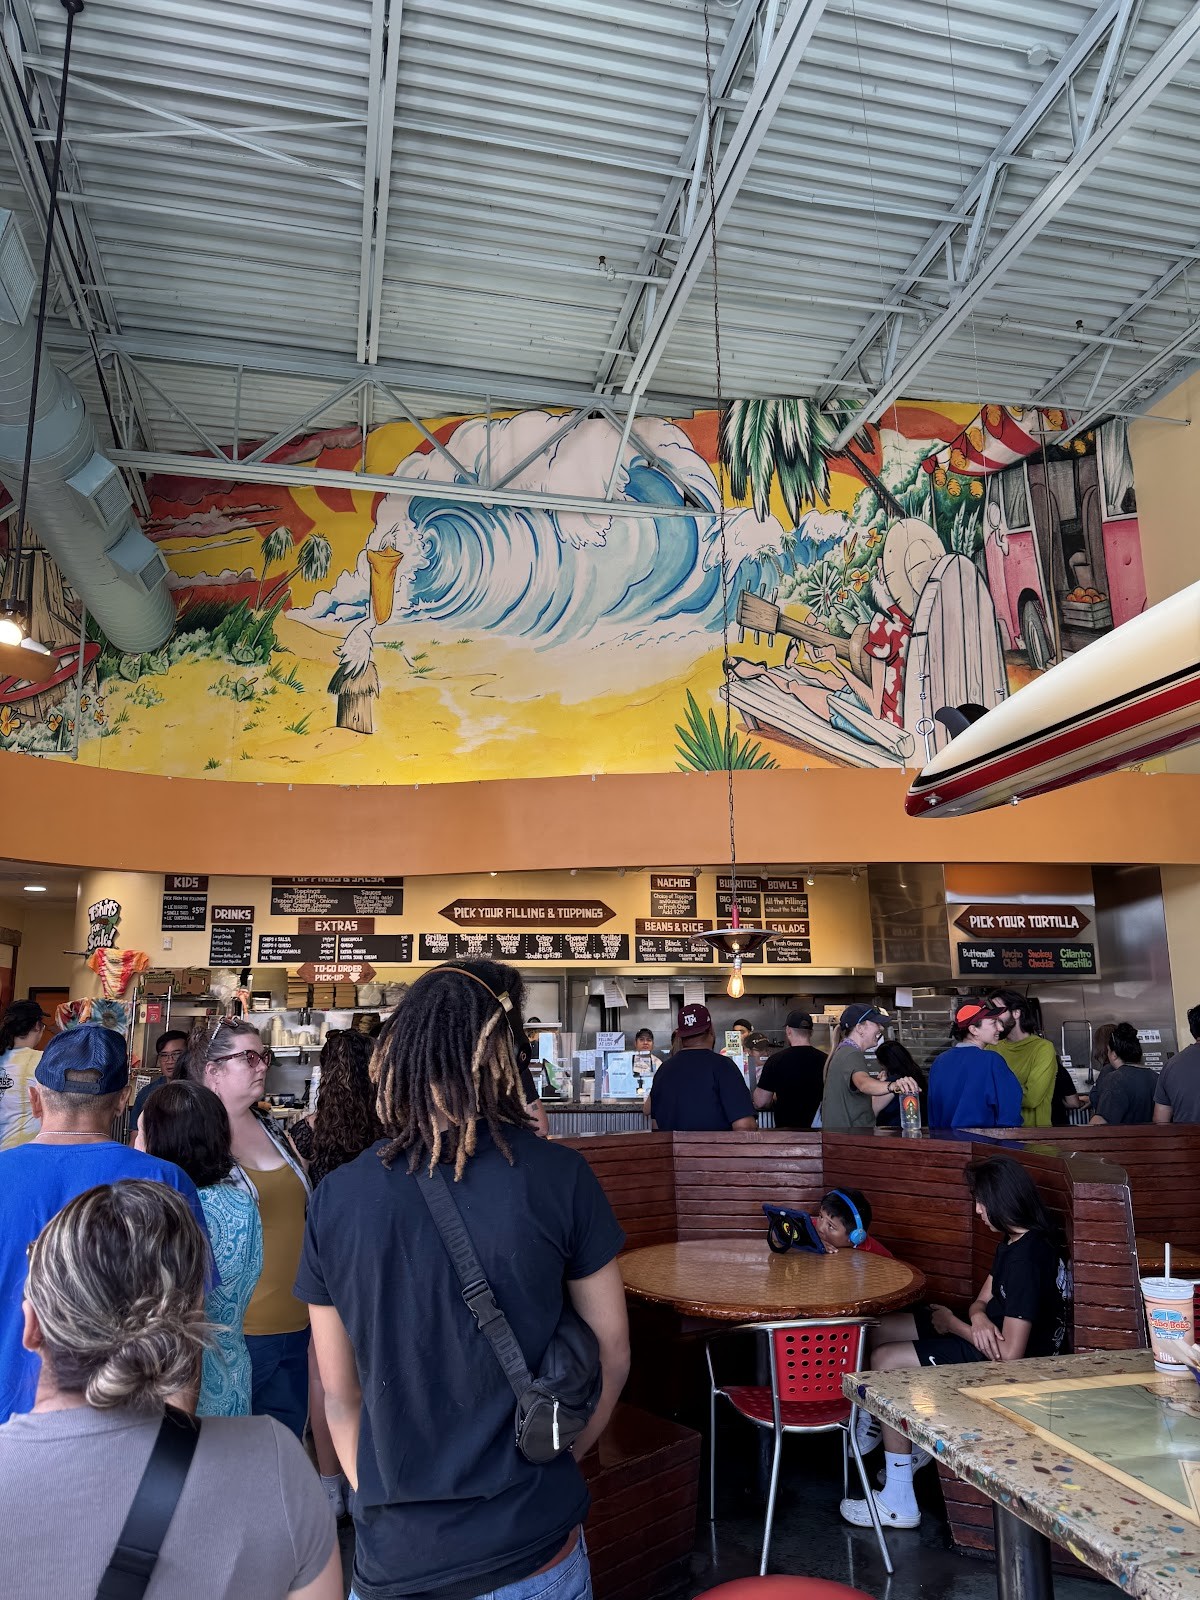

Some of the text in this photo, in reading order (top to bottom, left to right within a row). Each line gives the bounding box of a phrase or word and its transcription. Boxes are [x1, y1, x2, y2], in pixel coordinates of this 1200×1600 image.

[173, 877, 199, 888] KIDS
[657, 878, 691, 888] NACHOS
[768, 880, 798, 890] BOWLS
[719, 895, 731, 903] BIG
[214, 909, 252, 920] DRINKS
[453, 907, 603, 919] PICK YOUR FILLING & TOPPINGS
[315, 920, 358, 931] EXTRAS
[969, 915, 1080, 928] PICK YOUR TORTILLA
[644, 921, 704, 933] BEANS & RICE
[771, 923, 805, 933] SALADS
[88, 928, 117, 950] Sale!
[460, 933, 488, 941] Shredded
[565, 934, 588, 942] Chopped
[641, 939, 654, 947] Baja
[664, 939, 681, 947] Black
[962, 948, 996, 958] Buttermilk
[1001, 949, 1024, 958] Ancho
[1027, 949, 1053, 960] Smokey
[1060, 948, 1092, 959] Cilantro
[970, 959, 989, 968] Flour
[1003, 959, 1023, 968] Chile
[1028, 959, 1056, 968] Cheddar
[1060, 959, 1093, 969] Tomatillo
[314, 965, 363, 973] TO-GO ORDER
[315, 974, 344, 982] PICK-UP
